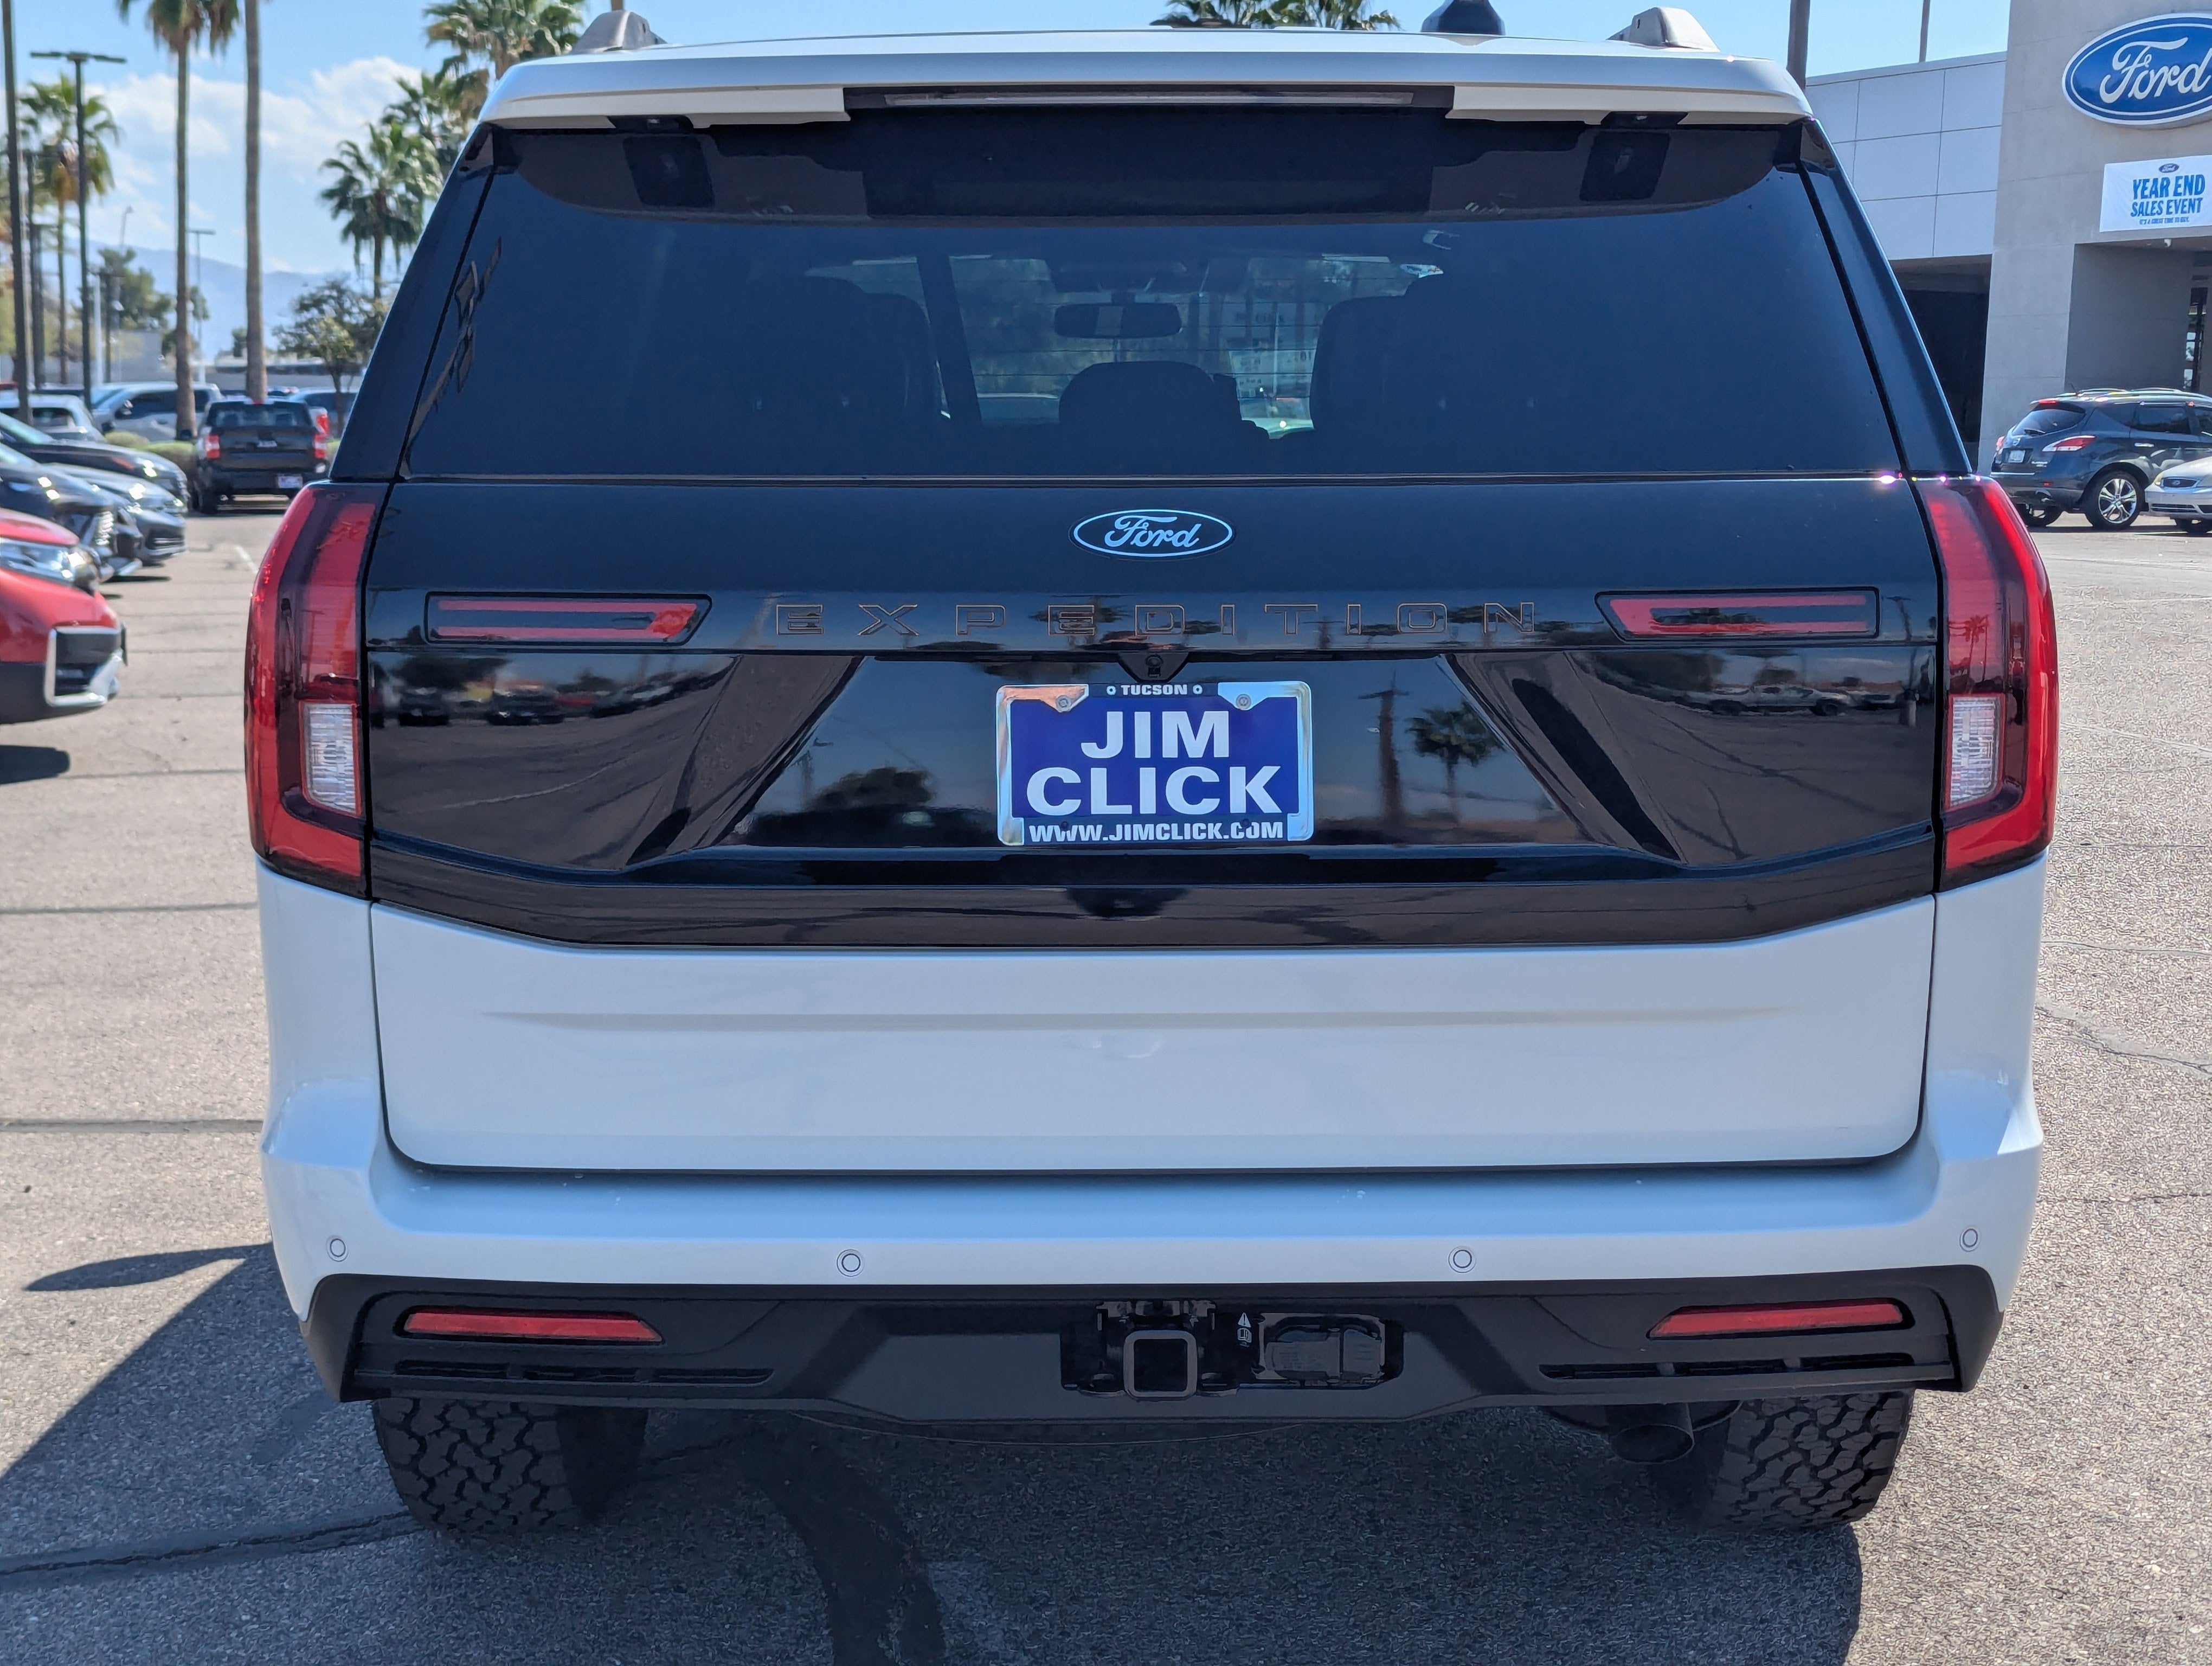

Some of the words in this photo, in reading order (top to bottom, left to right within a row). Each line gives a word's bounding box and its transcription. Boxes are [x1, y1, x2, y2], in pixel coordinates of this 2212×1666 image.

[2099, 37, 2212, 103] Ford
[2133, 177, 2171, 200] YEAR
[2173, 174, 2205, 197] END
[2130, 200, 2164, 217] SALES
[2166, 197, 2203, 215] EVENT
[1104, 515, 1202, 547] Ford
[775, 602, 1536, 636] EXPEDITION
[1121, 684, 1188, 696] TUCSON
[1081, 710, 1230, 759] JIM
[1026, 765, 1283, 816] CLICK
[1029, 821, 1284, 842] WWW.JIMCLICK.COM
